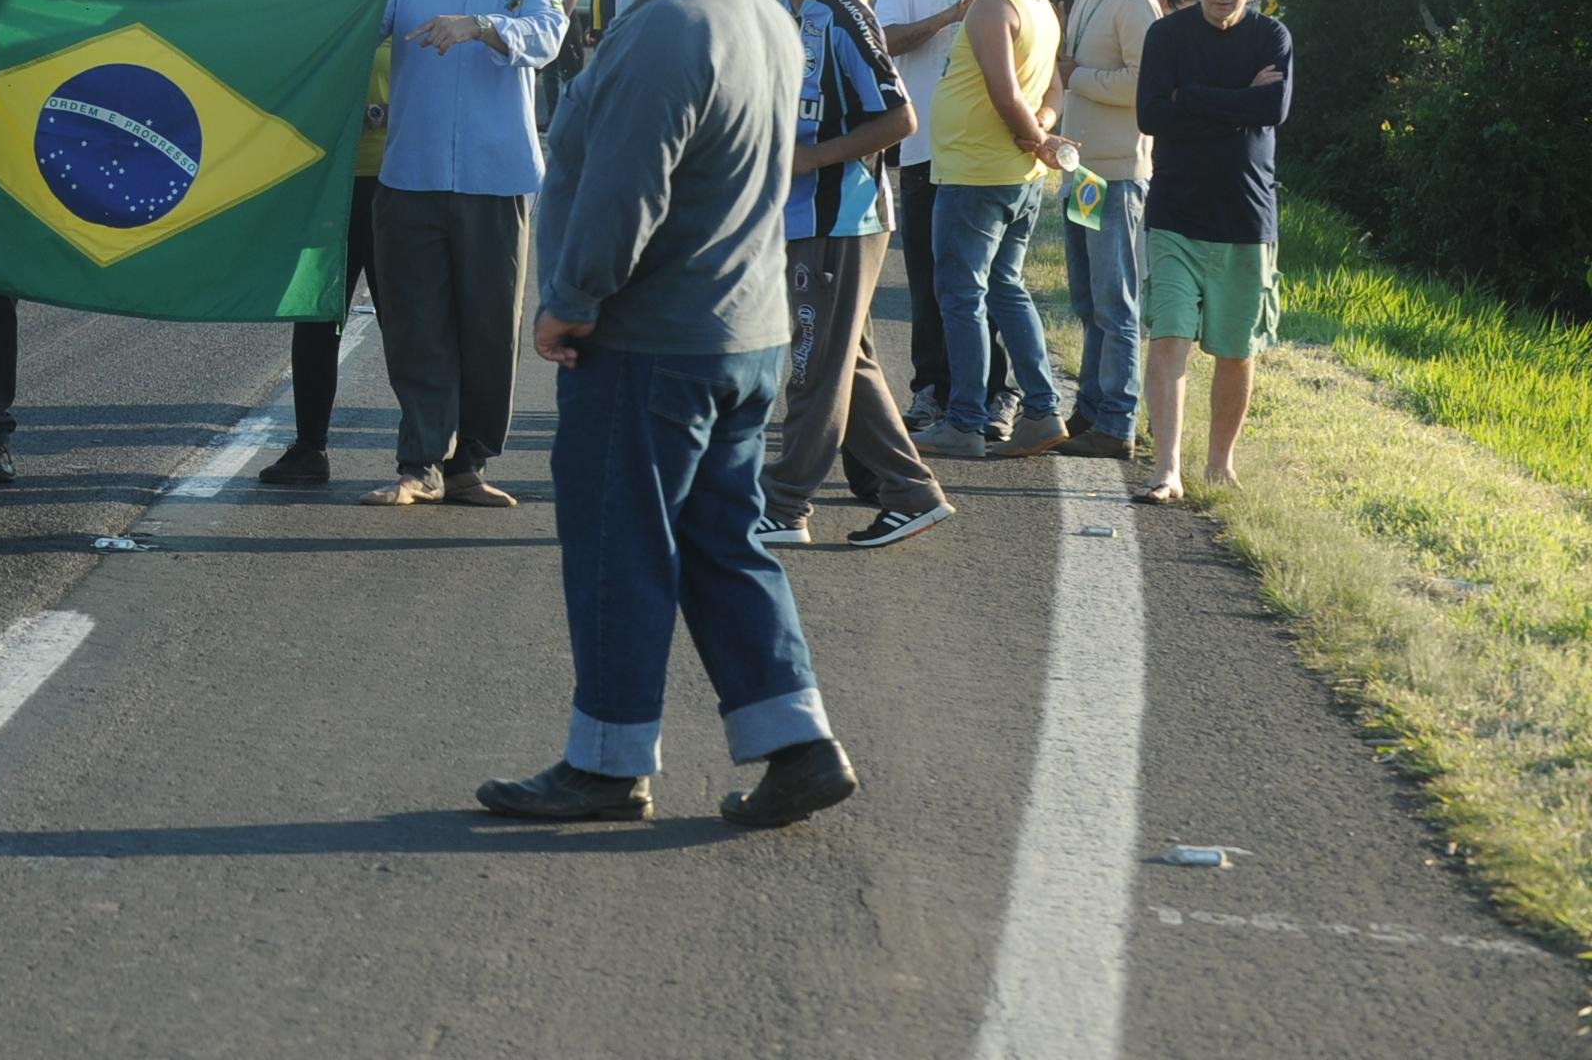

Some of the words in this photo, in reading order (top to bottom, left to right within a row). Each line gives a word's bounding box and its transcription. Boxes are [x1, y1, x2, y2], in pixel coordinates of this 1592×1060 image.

[49, 98, 99, 117] ORDEM
[108, 113, 118, 123] E
[124, 120, 197, 173] PROGRESSO
